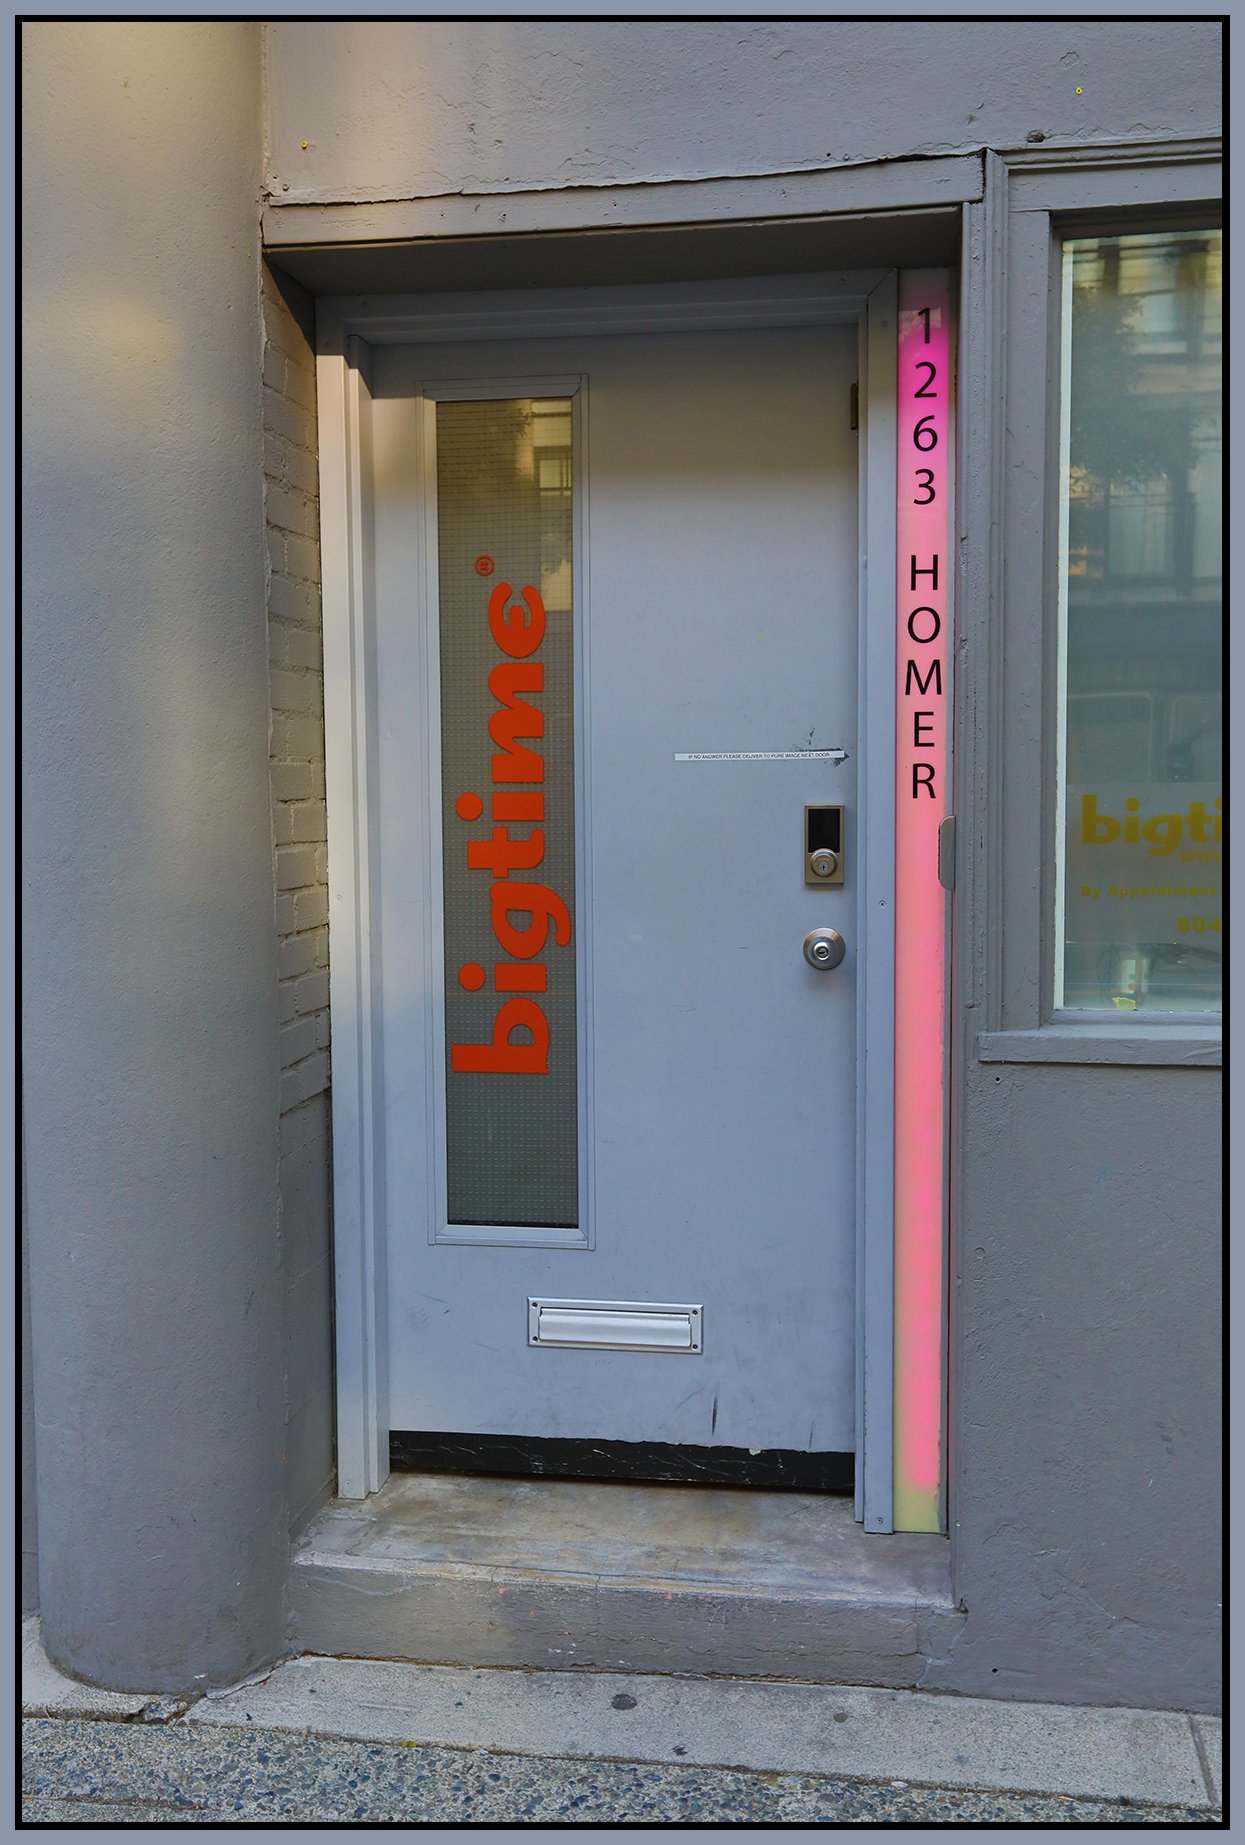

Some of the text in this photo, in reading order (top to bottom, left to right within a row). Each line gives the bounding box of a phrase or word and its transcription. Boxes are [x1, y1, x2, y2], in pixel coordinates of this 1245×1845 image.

[905, 307, 942, 799] 1263 HOMER
[451, 582, 571, 1075] bigtime
[1081, 884, 1216, 899] By Appointment
[1177, 916, 1222, 933] 604
